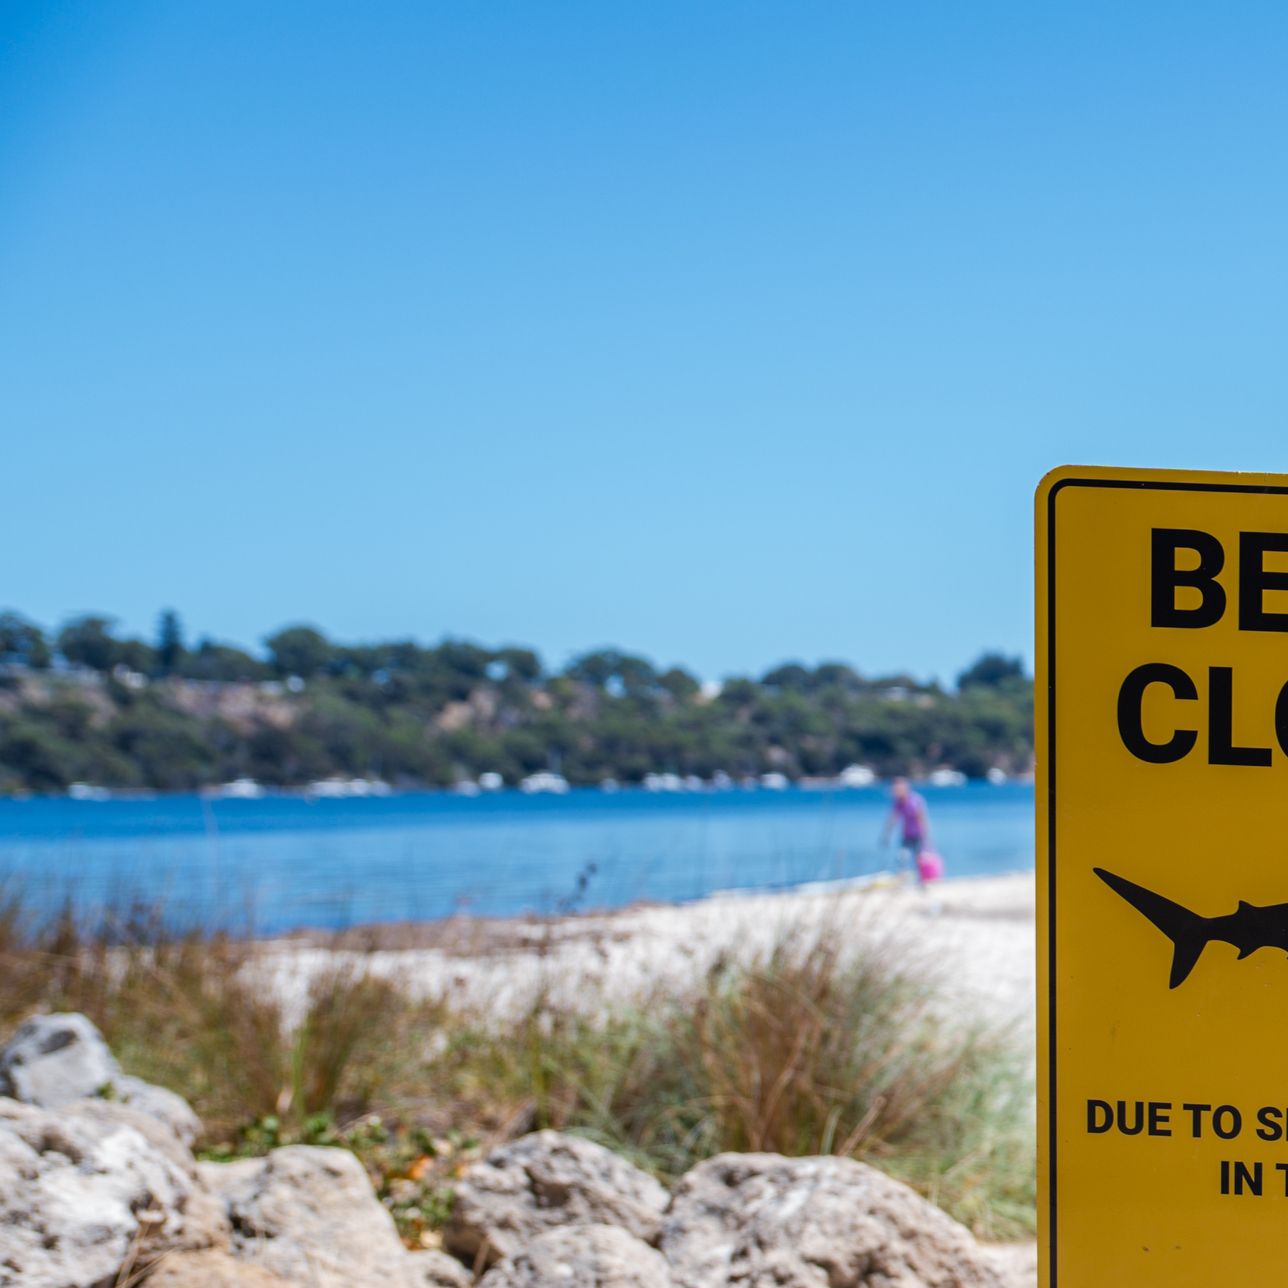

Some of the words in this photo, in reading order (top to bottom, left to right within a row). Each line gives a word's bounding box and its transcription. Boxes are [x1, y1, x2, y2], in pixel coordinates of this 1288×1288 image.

[1086, 1099, 1172, 1137] DUE
[1182, 1103, 1242, 1140] TO
[1220, 1160, 1263, 1197] IN
